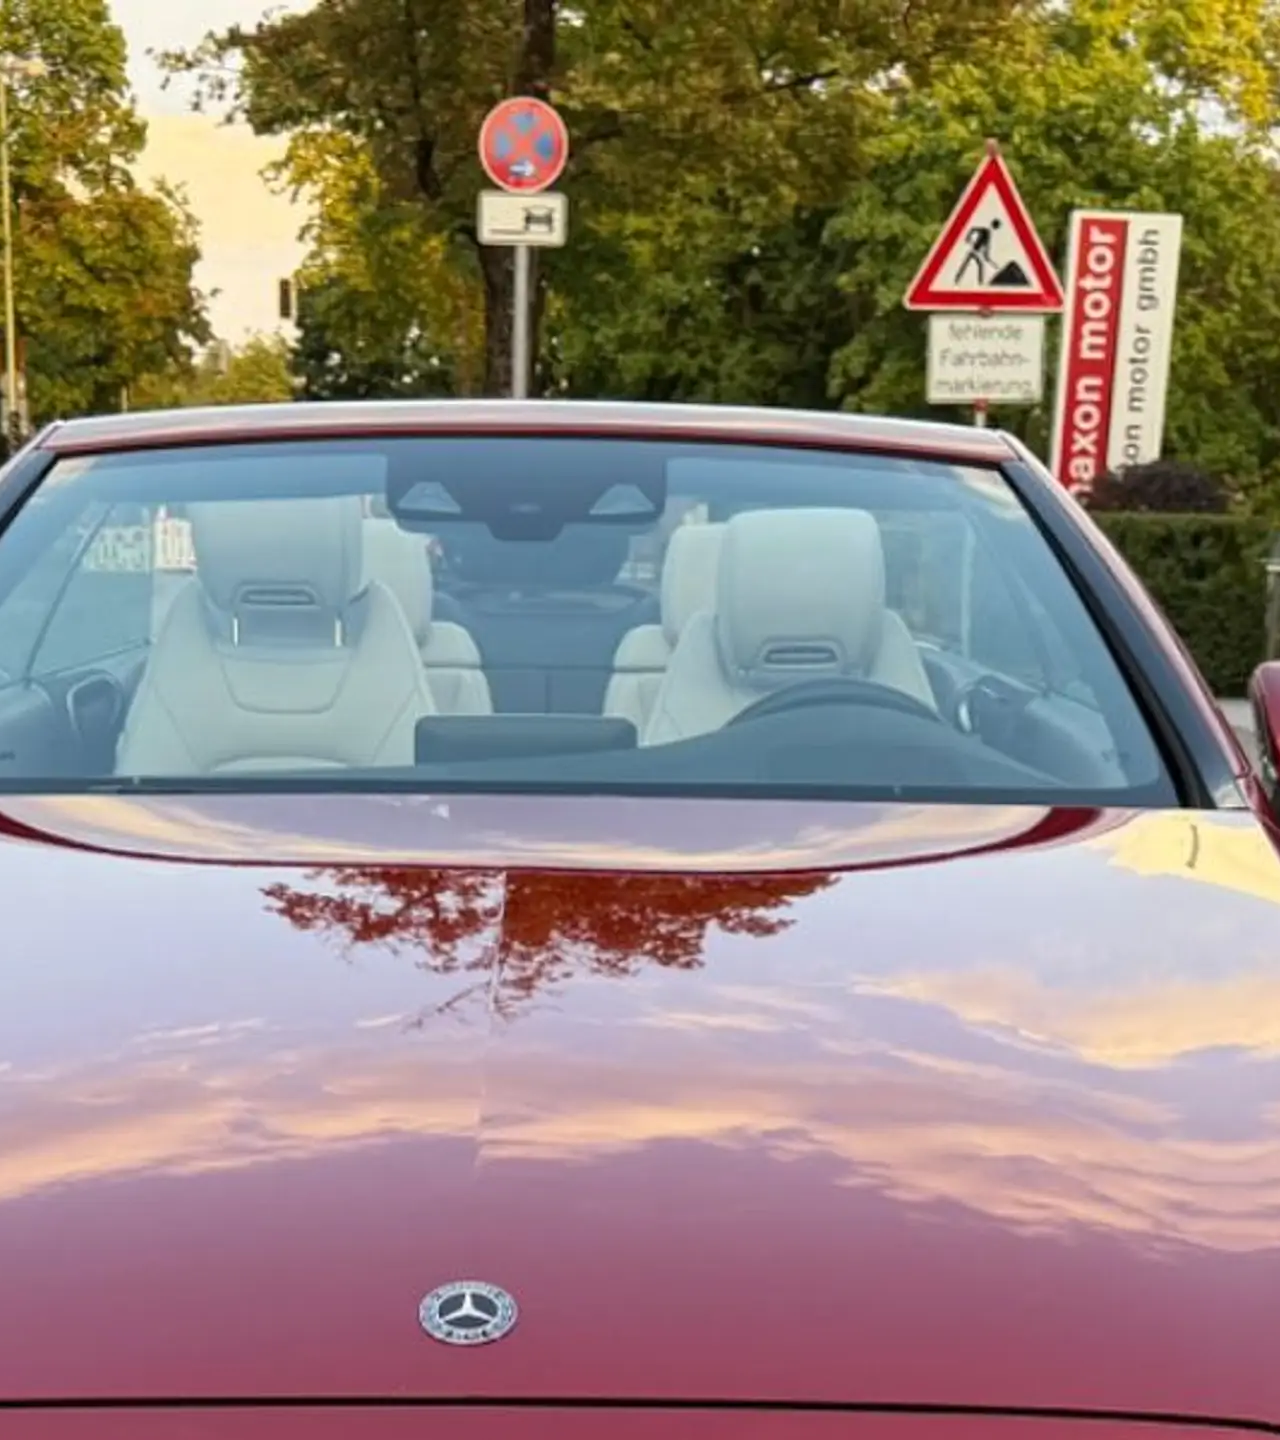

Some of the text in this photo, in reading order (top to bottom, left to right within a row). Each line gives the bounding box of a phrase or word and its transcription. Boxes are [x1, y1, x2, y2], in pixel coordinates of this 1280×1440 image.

[1079, 225, 1117, 360] motor
[1136, 228, 1160, 312] gmbh
[1127, 326, 1151, 413] motor
